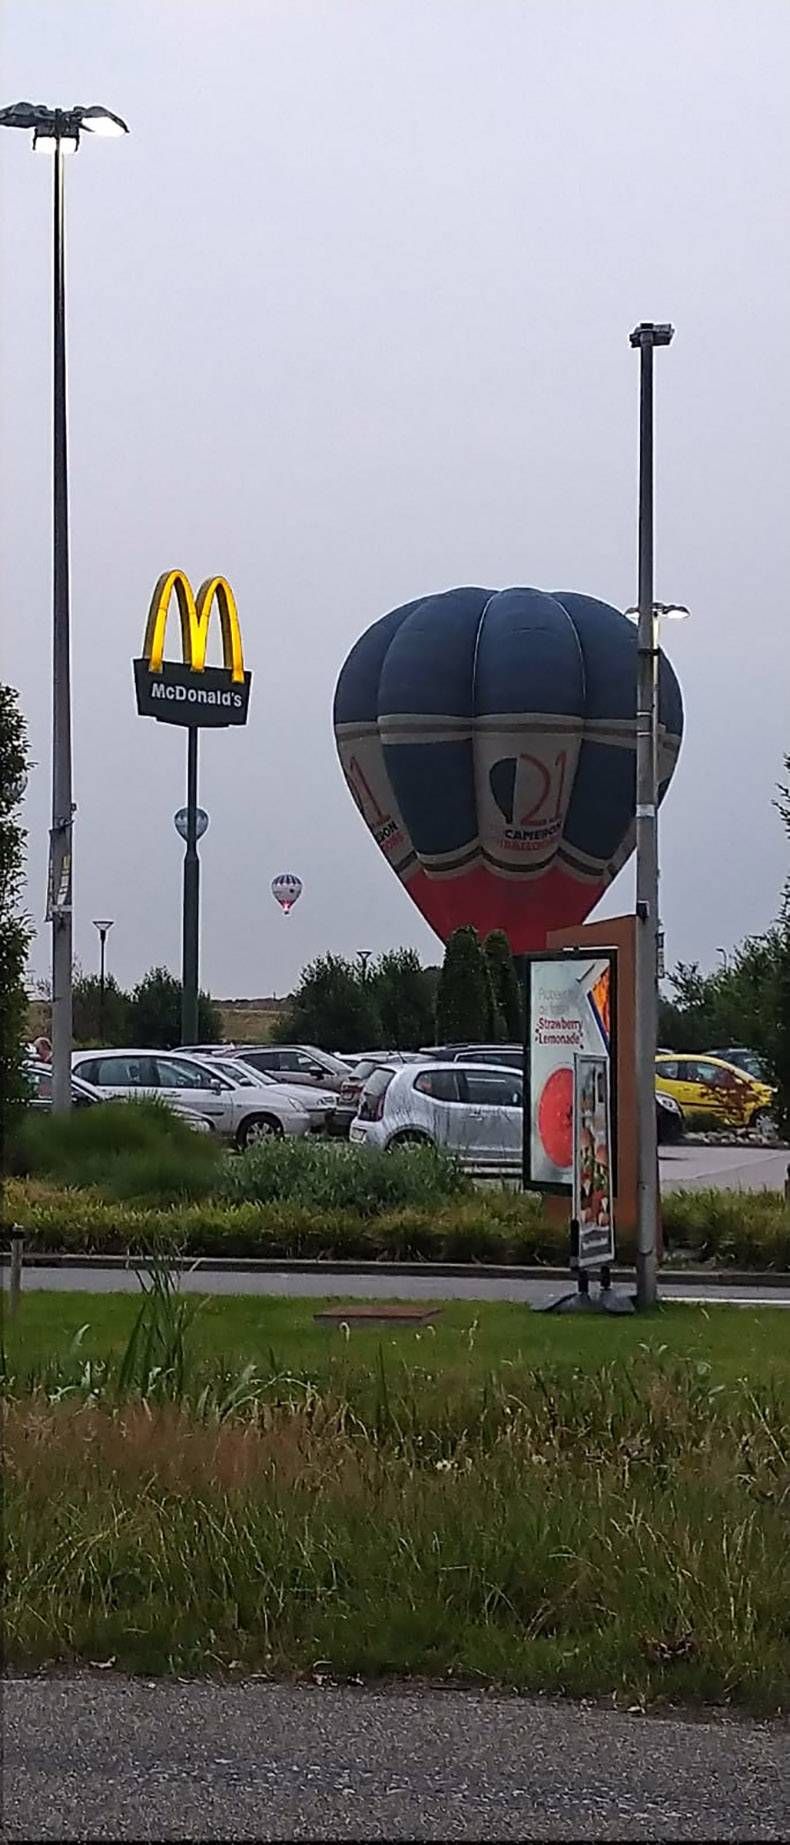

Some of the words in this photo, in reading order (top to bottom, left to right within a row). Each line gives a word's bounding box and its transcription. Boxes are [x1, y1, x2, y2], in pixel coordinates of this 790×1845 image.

[151, 682, 242, 707] McDonald's
[504, 821, 562, 841] CAMERON
[539, 1017, 583, 1033] Strawberry
[539, 1032, 580, 1045] Lemonade
